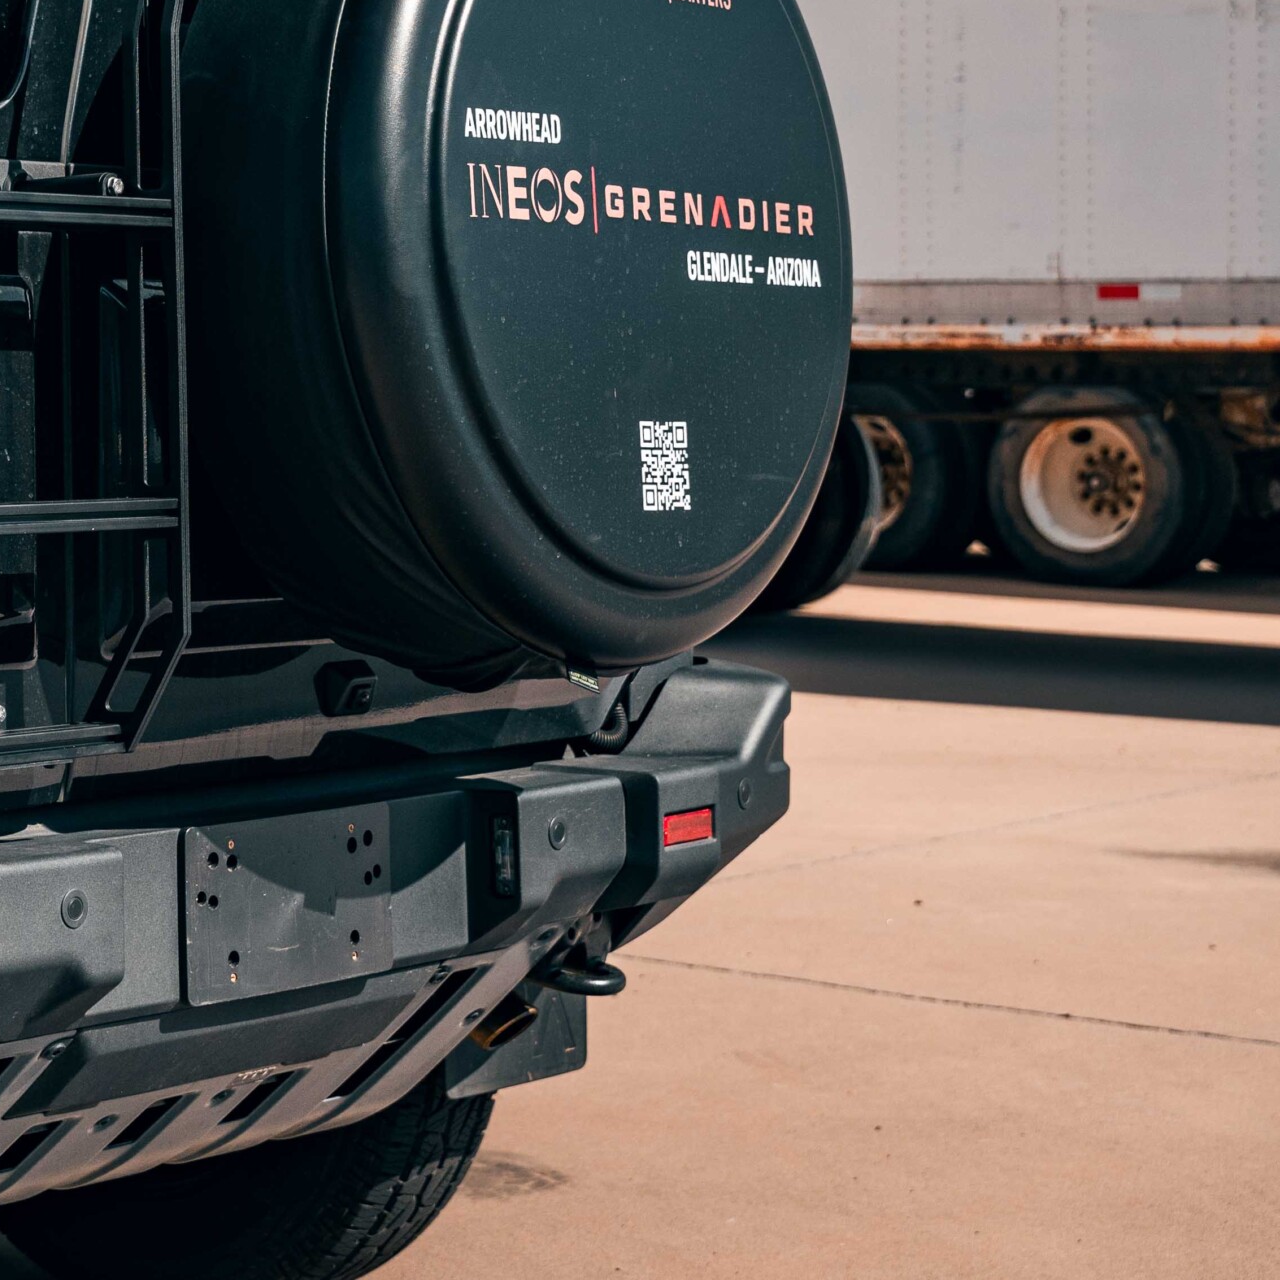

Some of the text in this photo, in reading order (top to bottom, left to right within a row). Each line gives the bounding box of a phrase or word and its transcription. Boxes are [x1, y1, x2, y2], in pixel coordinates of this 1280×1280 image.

[464, 106, 562, 145] ARROWHEAD
[466, 162, 815, 237] INEOS GRENADIER
[686, 249, 754, 284] GLENDALE
[766, 256, 822, 288] ARIZONA
